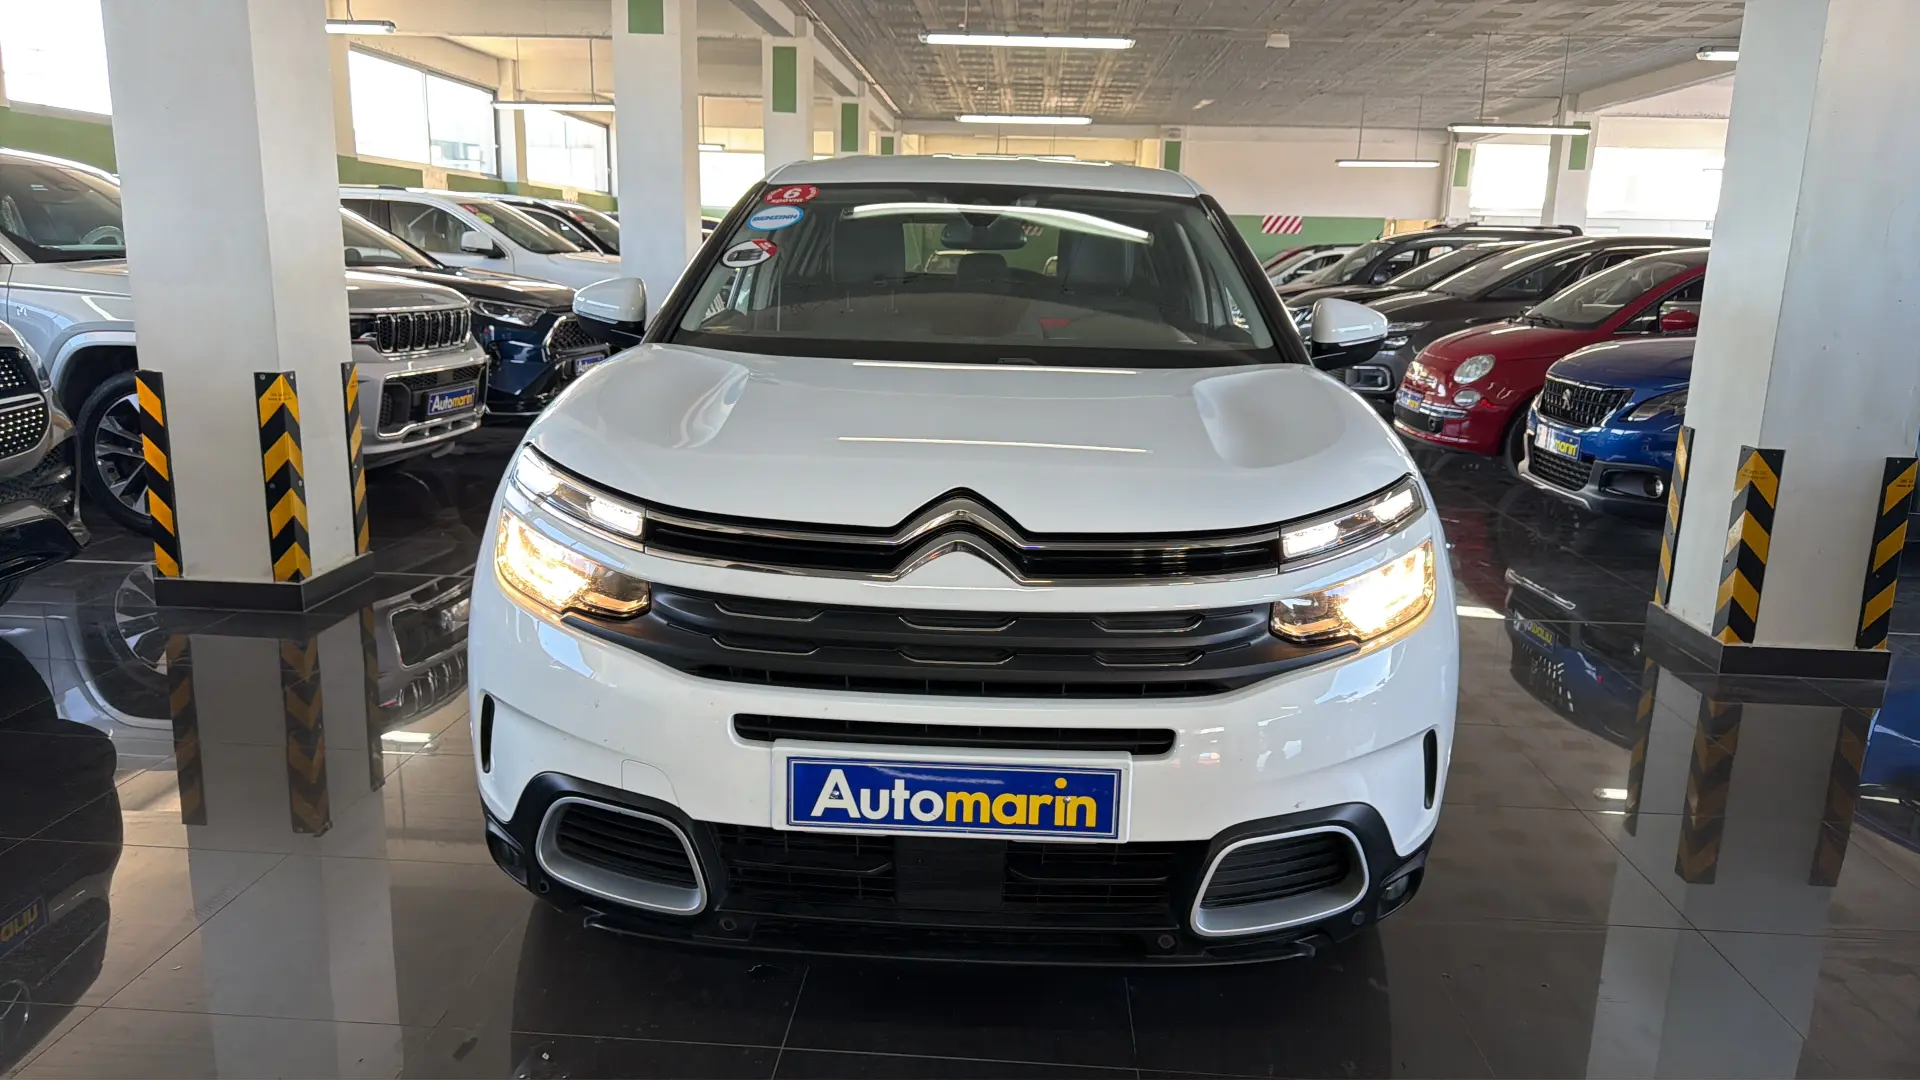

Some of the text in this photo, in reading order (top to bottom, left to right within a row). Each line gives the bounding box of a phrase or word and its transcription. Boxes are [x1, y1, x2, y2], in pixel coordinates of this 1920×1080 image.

[782, 188, 803, 199] 6
[431, 389, 473, 413] Automarin
[810, 768, 1097, 829] Automarin
